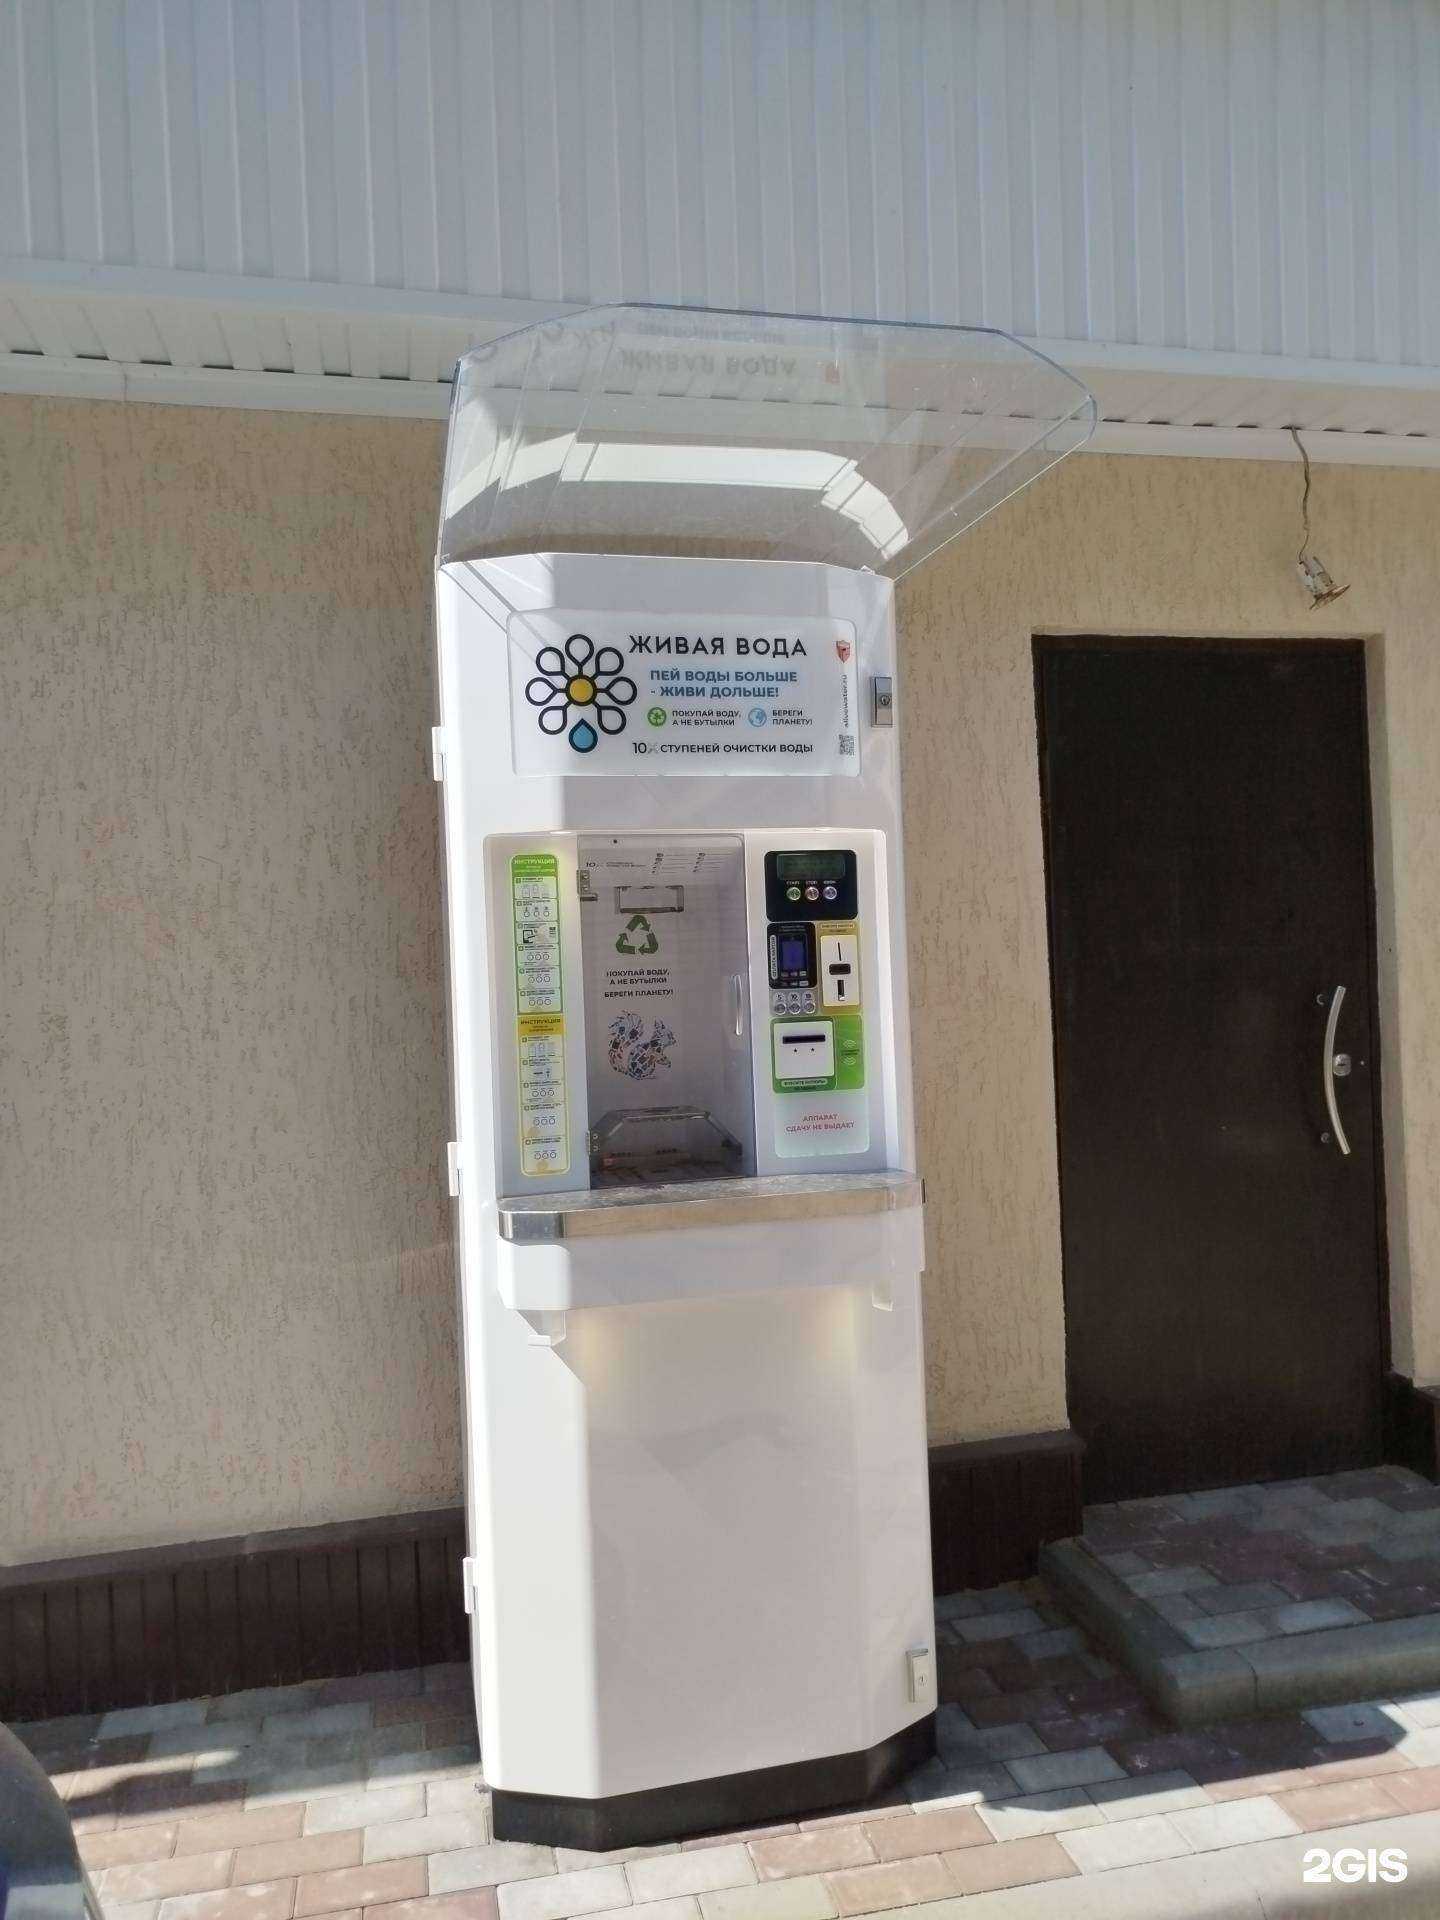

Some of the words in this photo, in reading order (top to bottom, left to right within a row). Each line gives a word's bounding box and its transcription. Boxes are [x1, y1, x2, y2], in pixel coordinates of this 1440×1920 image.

[629, 635, 725, 655] ЖИВАЯ
[736, 638, 807, 658] ВОДА
[650, 668, 680, 681] ПЕЙ
[685, 671, 730, 683] ВОДЫ
[735, 671, 798, 682] БОЛЬШЕ
[660, 686, 706, 697] ЖИВИ
[710, 686, 779, 698] ДОЛЬШЕ!
[672, 709, 713, 717] ПОКУПАЙ
[716, 710, 741, 718] ВОДУ,
[772, 709, 803, 717] БЕРЕГИ
[772, 718, 813, 726] ПЛАНЕТУ!
[632, 742, 647, 754] 10
[660, 743, 720, 753] СТУПЕНЕЙ
[723, 744, 777, 753] ОЧИСТКИ
[779, 744, 813, 754] ВОДЫ
[606, 969, 645, 977] ПОКУПАЙ
[630, 977, 667, 985] БУТЫЛКИ
[604, 990, 633, 998] БЕРЕГИ
[803, 1113, 838, 1122] АППАРАТ
[786, 1124, 811, 1132] СДАЧУ
[824, 1122, 855, 1130] ВЫДАЕТ
